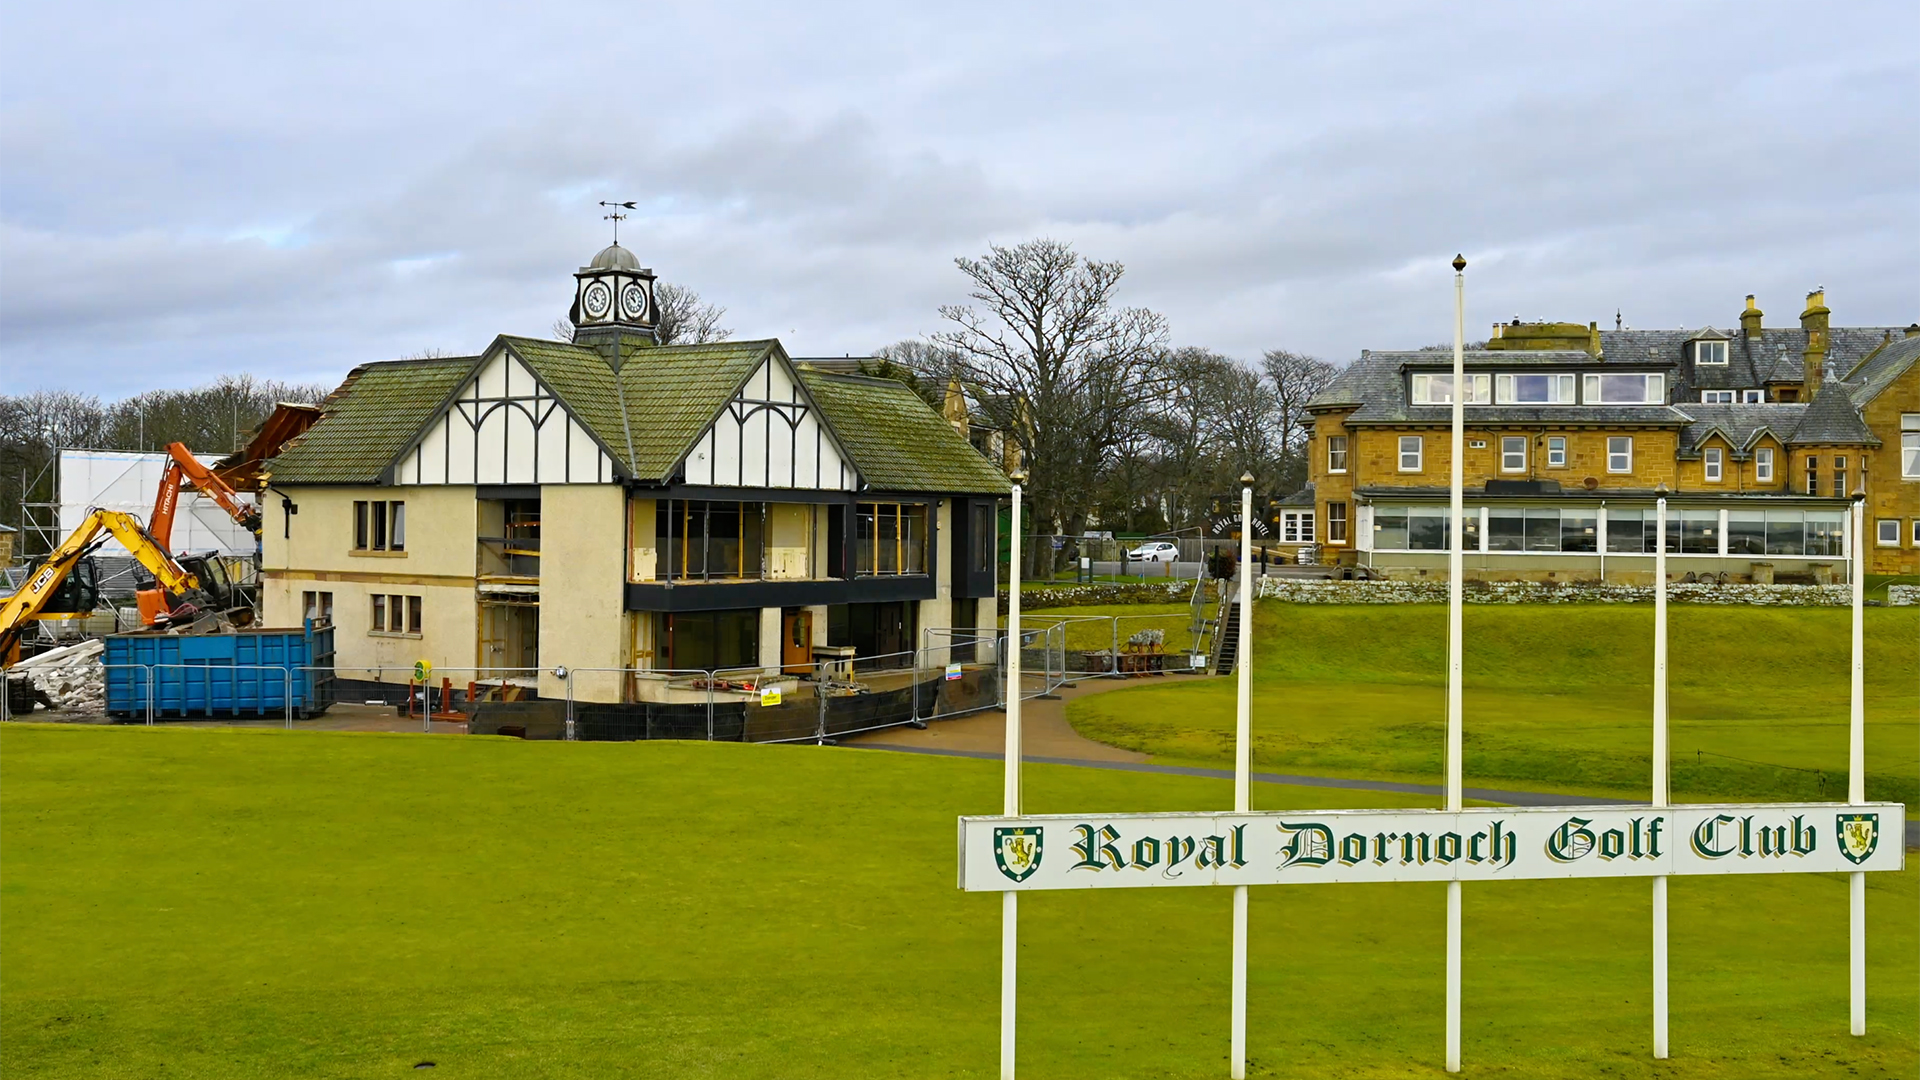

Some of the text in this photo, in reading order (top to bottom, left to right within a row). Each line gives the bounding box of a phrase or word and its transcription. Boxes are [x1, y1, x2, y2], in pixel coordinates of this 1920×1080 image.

[162, 484, 174, 515] HITACHI
[1212, 517, 1232, 535] ROYAL
[1252, 518, 1270, 536] HOTEL
[32, 567, 54, 593] JCB
[1067, 814, 1816, 879] Royal Dornoch Golf Club
